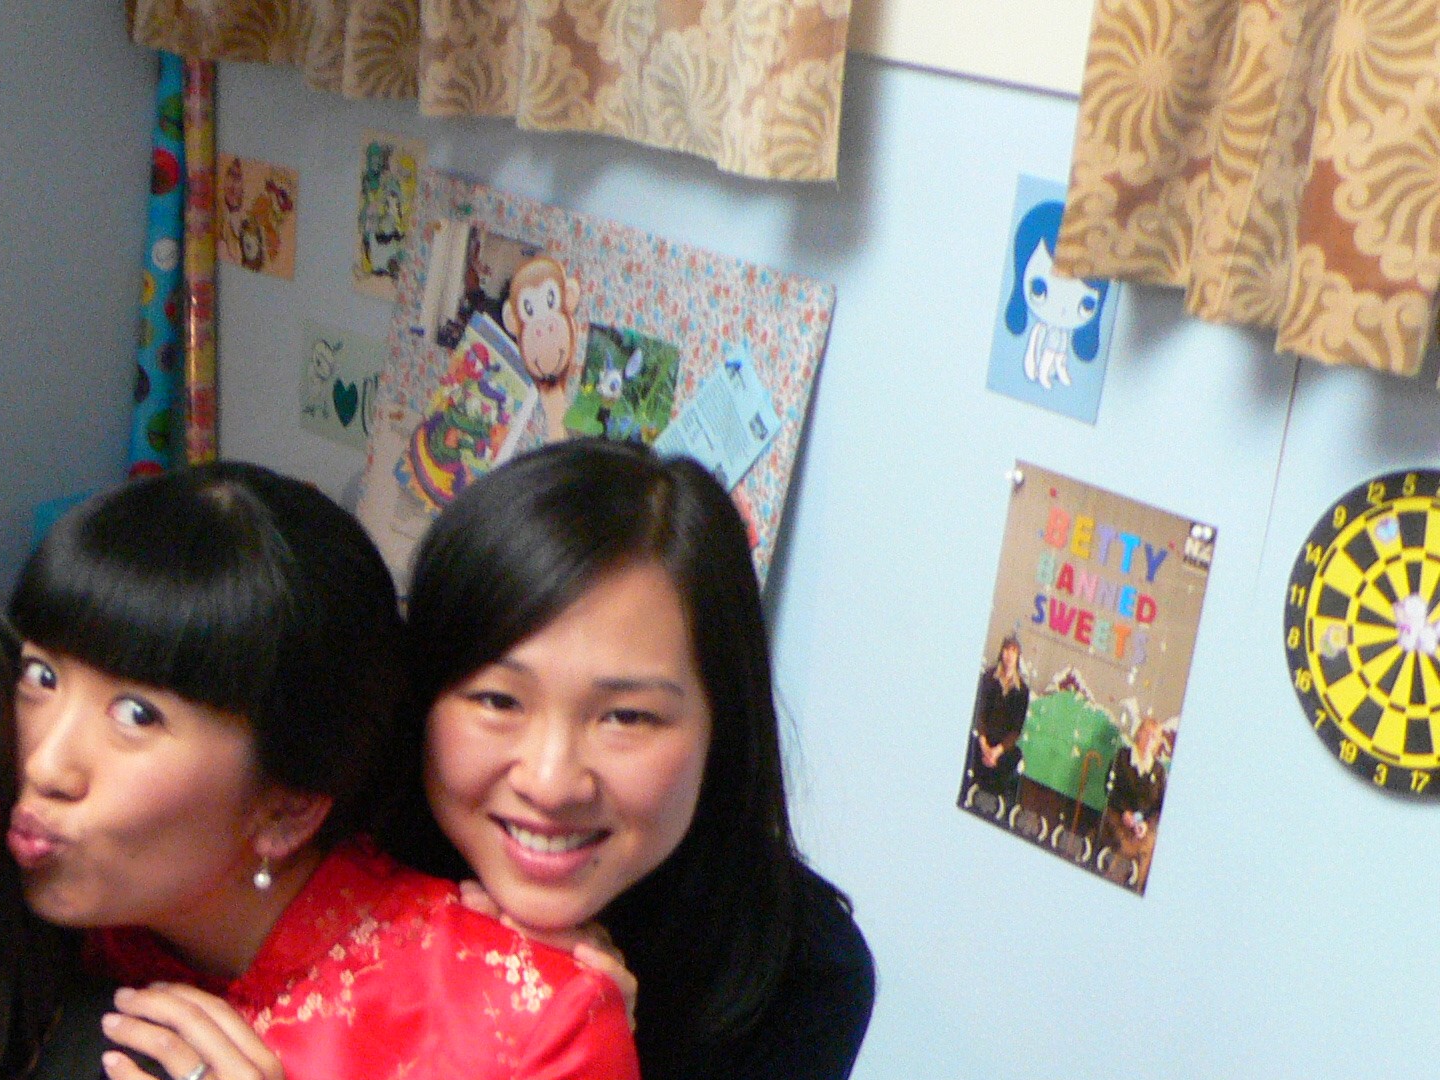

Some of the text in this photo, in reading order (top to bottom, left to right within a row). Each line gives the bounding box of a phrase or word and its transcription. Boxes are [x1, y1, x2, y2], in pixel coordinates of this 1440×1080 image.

[1333, 505, 1347, 528] 9
[1044, 506, 1168, 583] BETTY
[1305, 540, 1323, 566] 14
[1035, 552, 1158, 624] BANNED
[1290, 583, 1306, 608] 11
[1031, 593, 1150, 666] SWEETS
[1287, 625, 1301, 650] 8
[1295, 667, 1312, 693] 16
[1314, 709, 1327, 729] 7
[1373, 762, 1389, 787] 3
[1411, 769, 1431, 793] 17
